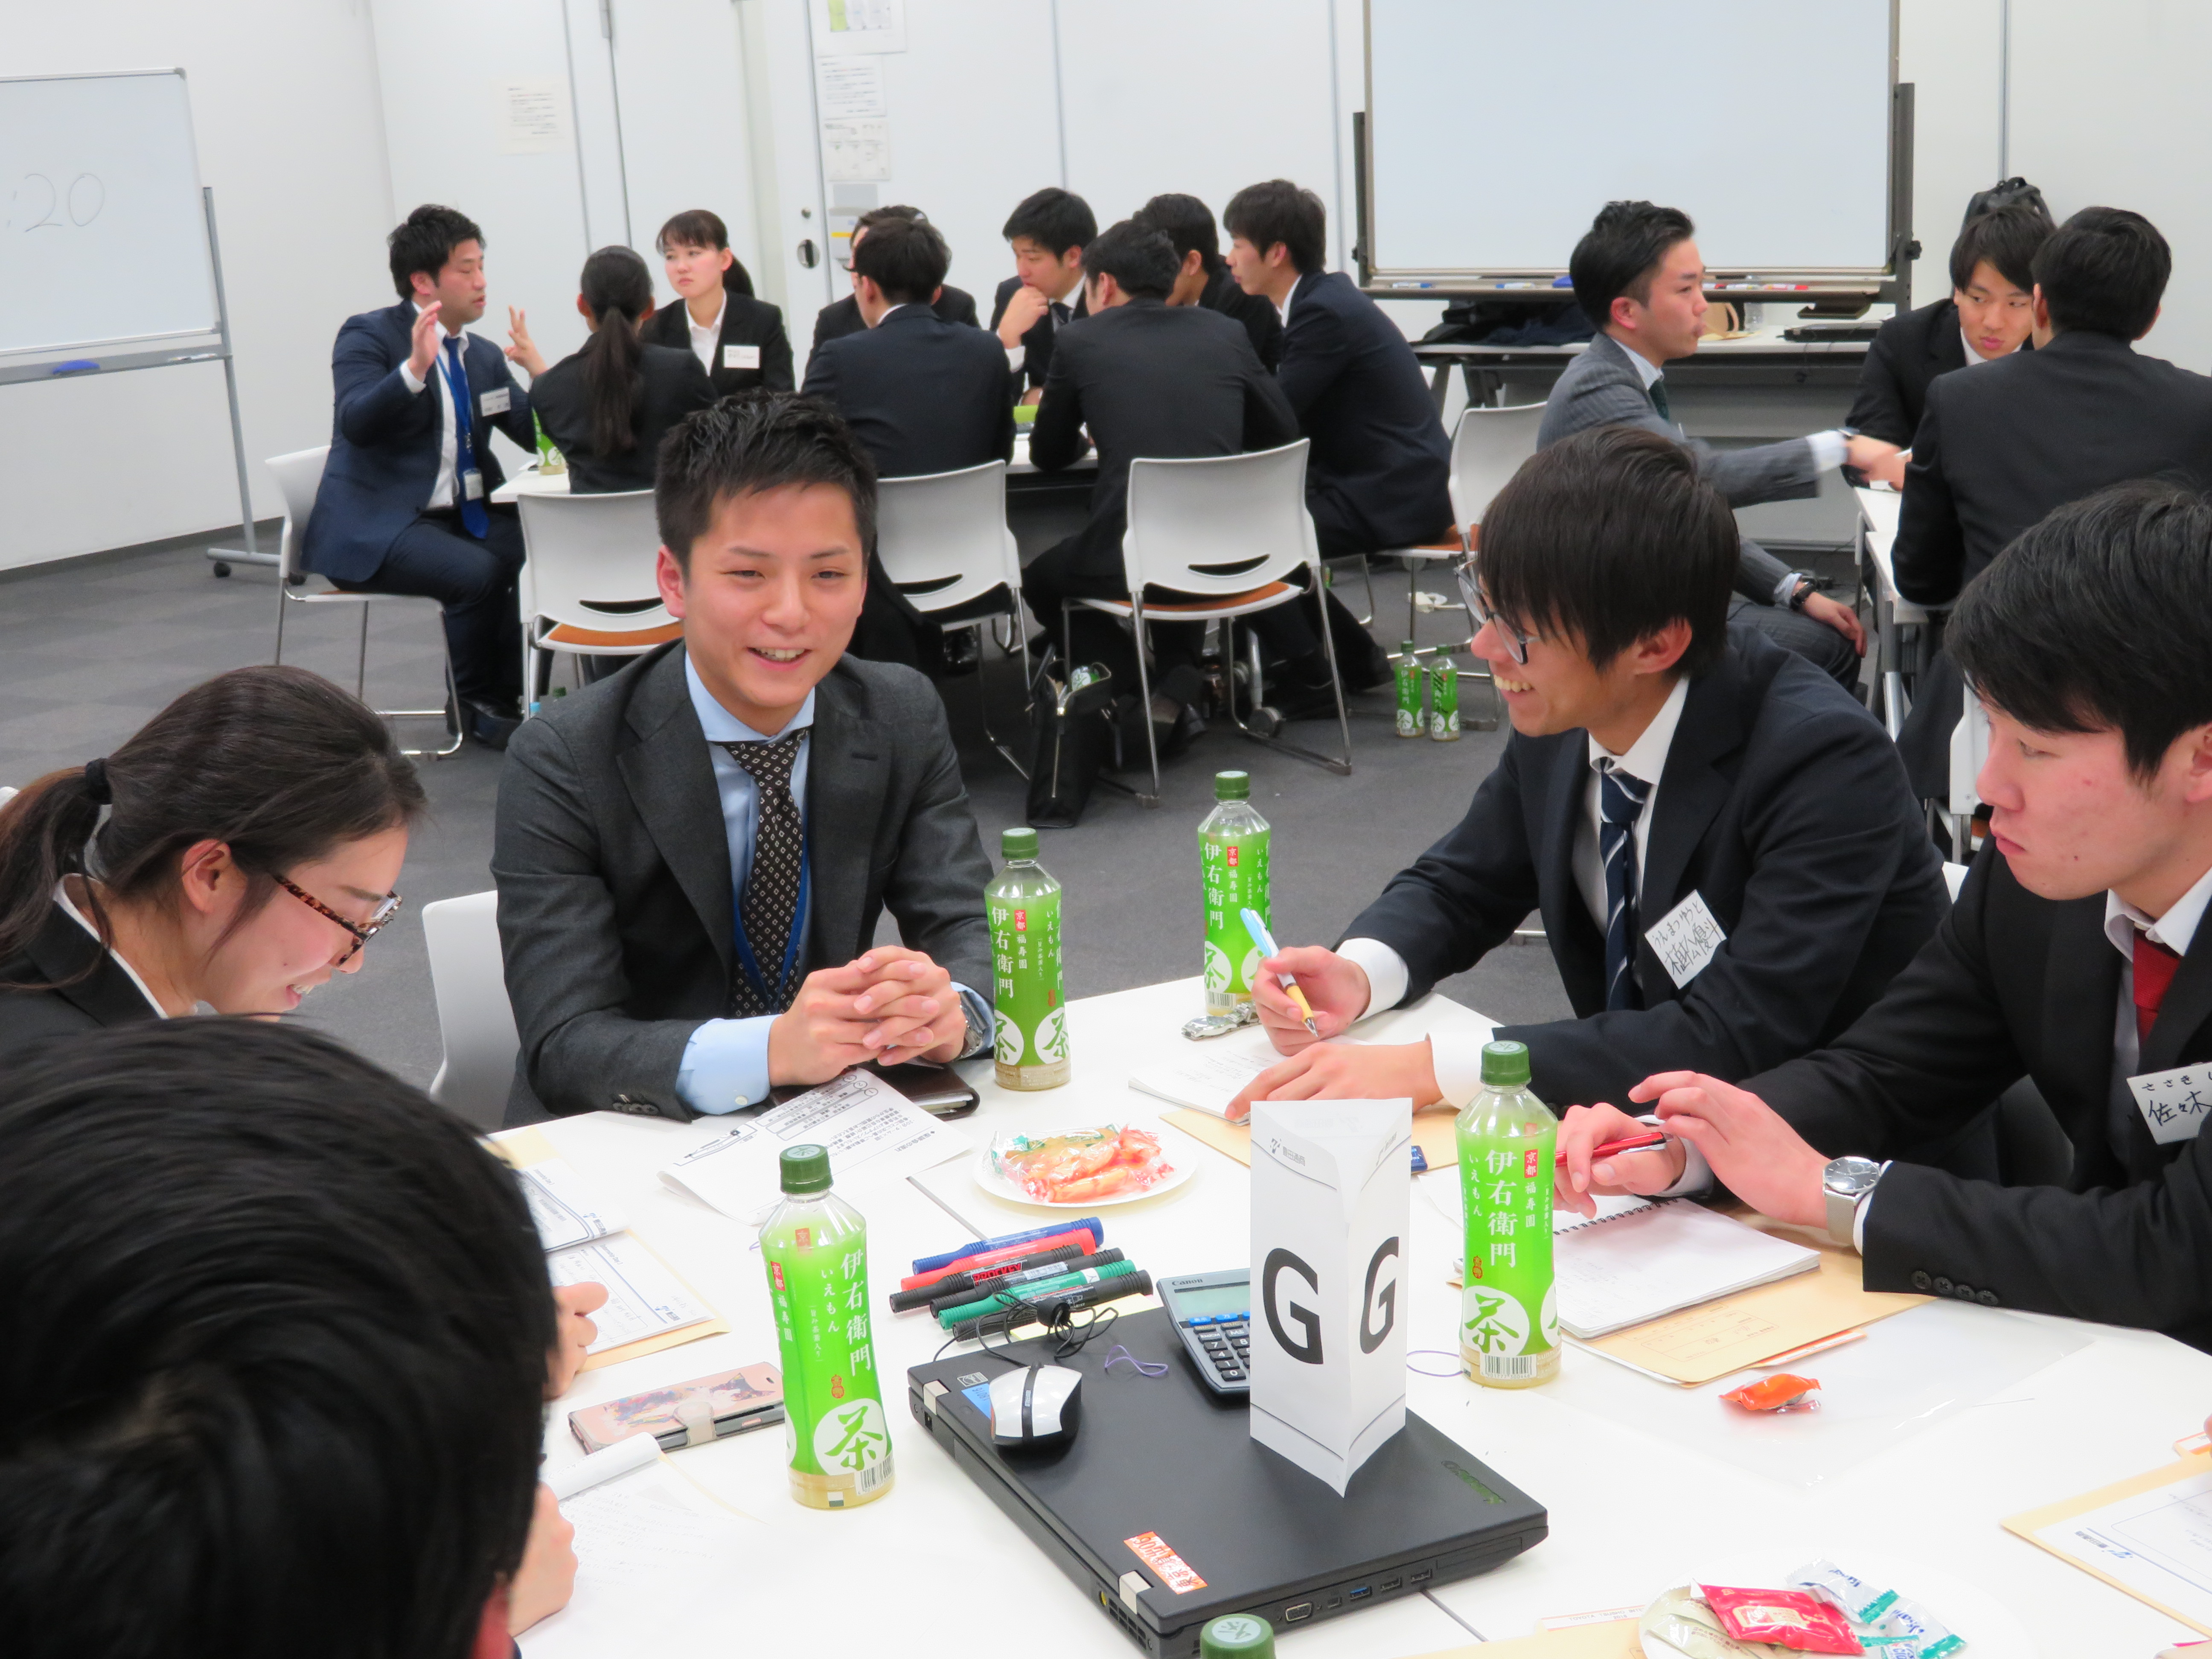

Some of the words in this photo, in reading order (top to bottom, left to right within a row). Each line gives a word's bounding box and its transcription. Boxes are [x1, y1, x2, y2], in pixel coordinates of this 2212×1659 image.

[1205, 842, 1225, 930] 伊右衛門
[1228, 848, 1237, 866] 京都
[1016, 911, 1025, 930] 京都
[1046, 911, 1054, 958] いえもん
[992, 906, 1014, 998] 伊右衛門
[2142, 1075, 2193, 1091] ささき
[2148, 1091, 2202, 1126] 佐々木
[1469, 1154, 1482, 1217] いえもん
[1526, 1152, 1537, 1176] 京都
[1485, 1149, 1518, 1268] 伊右衛門
[772, 1264, 784, 1289] 京都
[821, 1269, 839, 1333] いえもん
[1172, 1278, 1203, 1286] Canon
[1263, 1248, 1324, 1365] G
[1360, 1236, 1399, 1354] G
[841, 1249, 871, 1377] 伊右衛門
[1465, 1293, 1519, 1353] 茶
[824, 1406, 883, 1471] 茶
